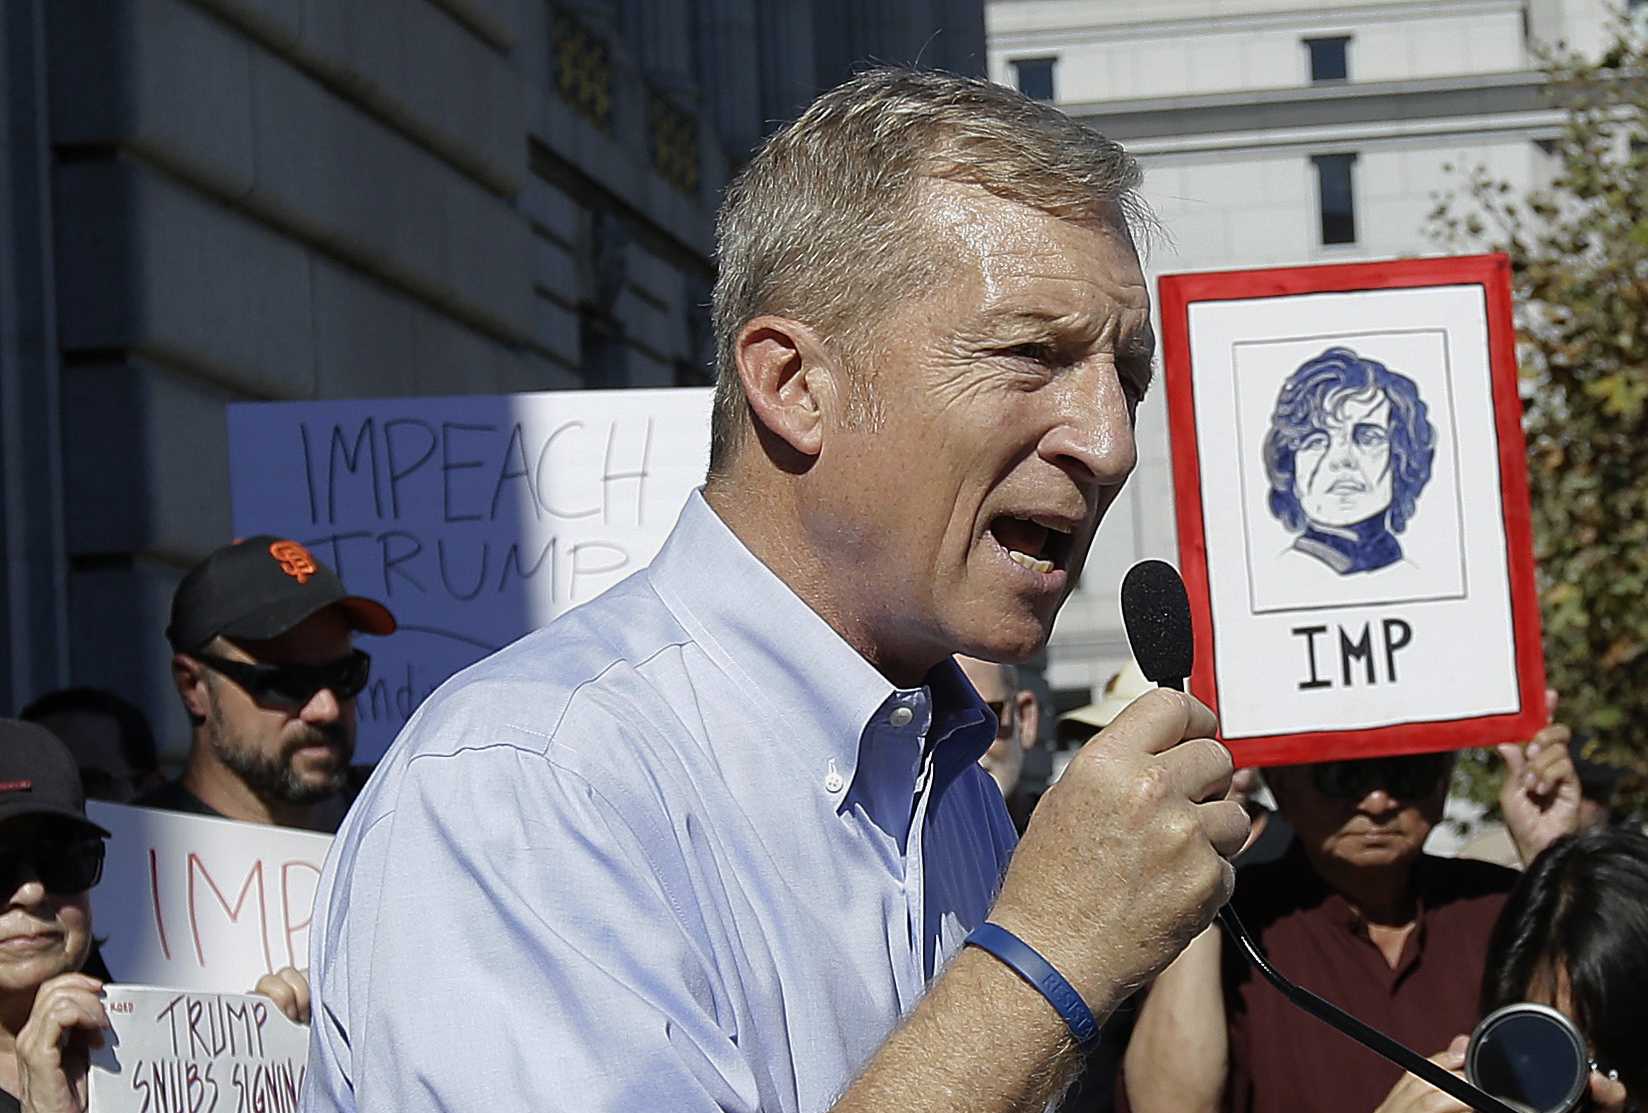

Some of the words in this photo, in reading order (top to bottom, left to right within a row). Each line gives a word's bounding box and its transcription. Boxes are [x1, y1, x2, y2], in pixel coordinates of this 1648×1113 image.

[300, 416, 655, 527] IMPEACH
[303, 531, 629, 603] TRUMP
[1290, 617, 1413, 692] IMP
[156, 995, 268, 1059] TRUMP
